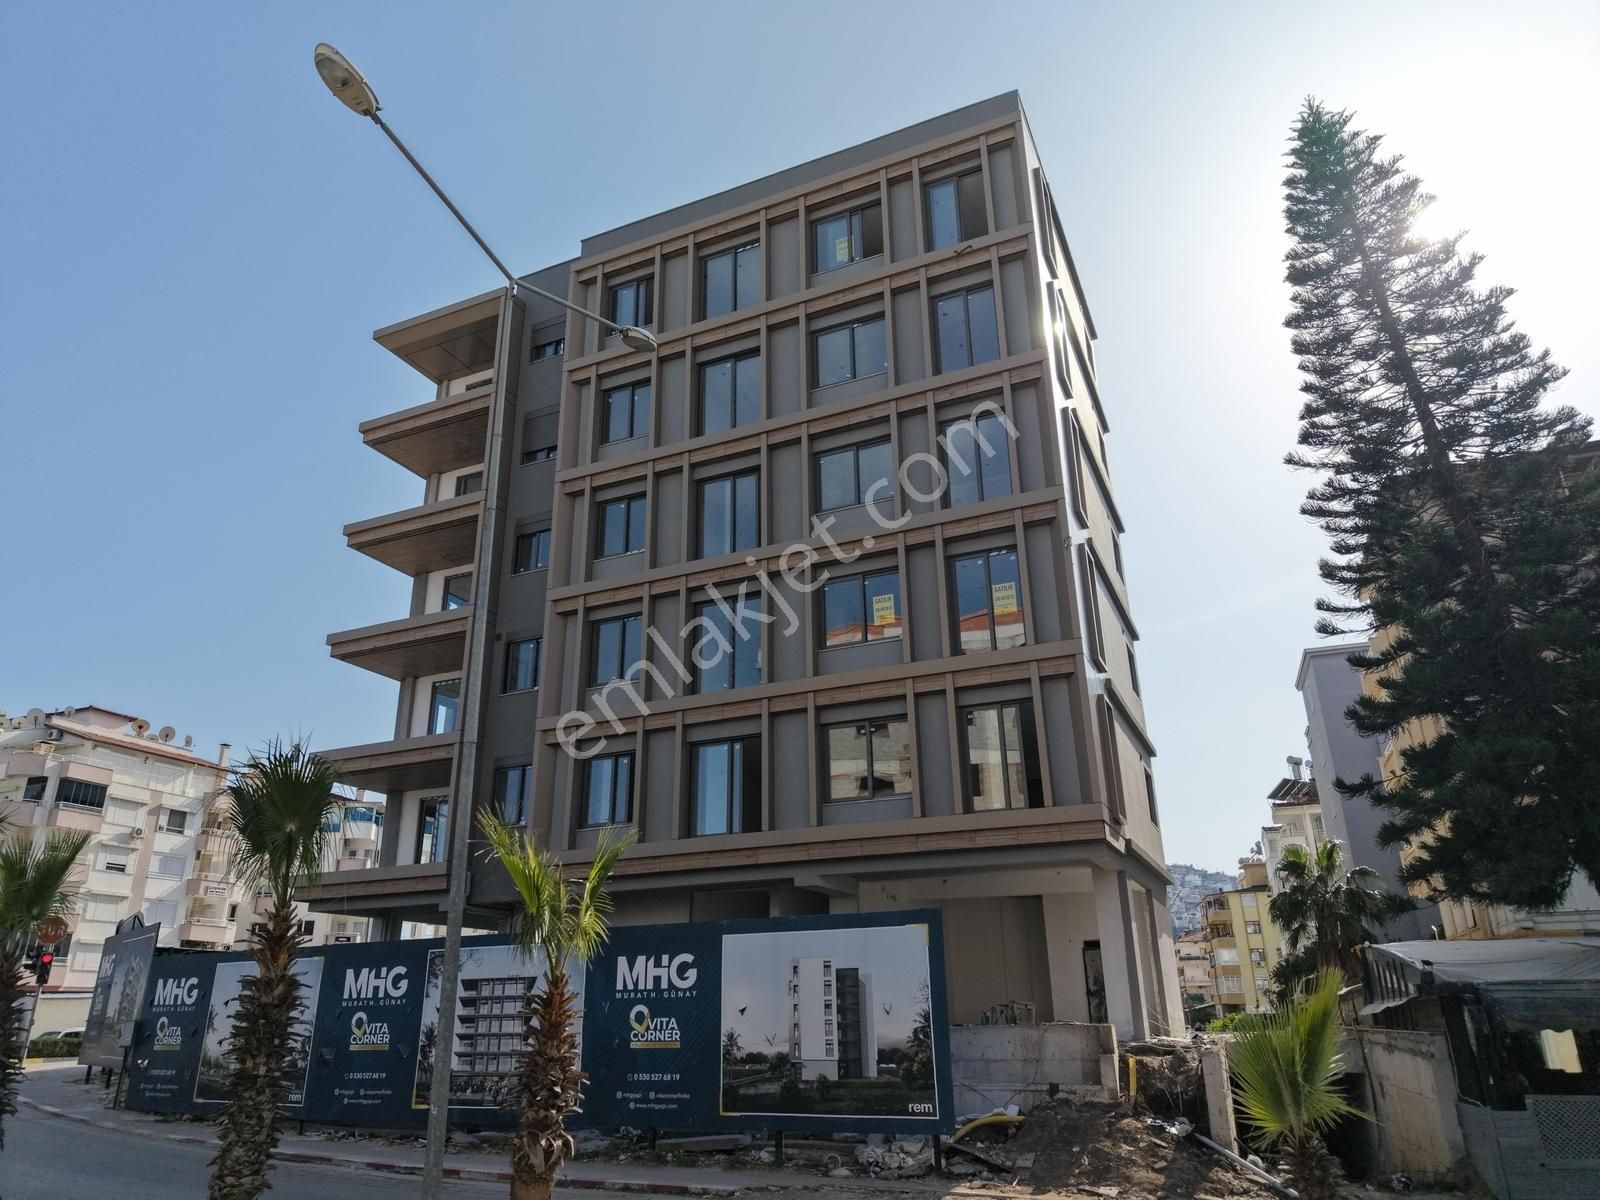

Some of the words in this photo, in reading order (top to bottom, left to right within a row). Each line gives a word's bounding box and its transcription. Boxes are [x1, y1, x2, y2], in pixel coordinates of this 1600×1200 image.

[616, 953, 697, 990] MHG
[343, 966, 408, 999] MHG
[154, 977, 199, 1006] MHG
[664, 990, 697, 998] GÜNAY
[365, 1023, 389, 1034] VITA
[648, 1018, 678, 1030] VITA
[350, 1034, 390, 1044] CORNER
[630, 1030, 681, 1041] CORNER
[288, 1094, 302, 1102] rem
[908, 1103, 933, 1113] rem
